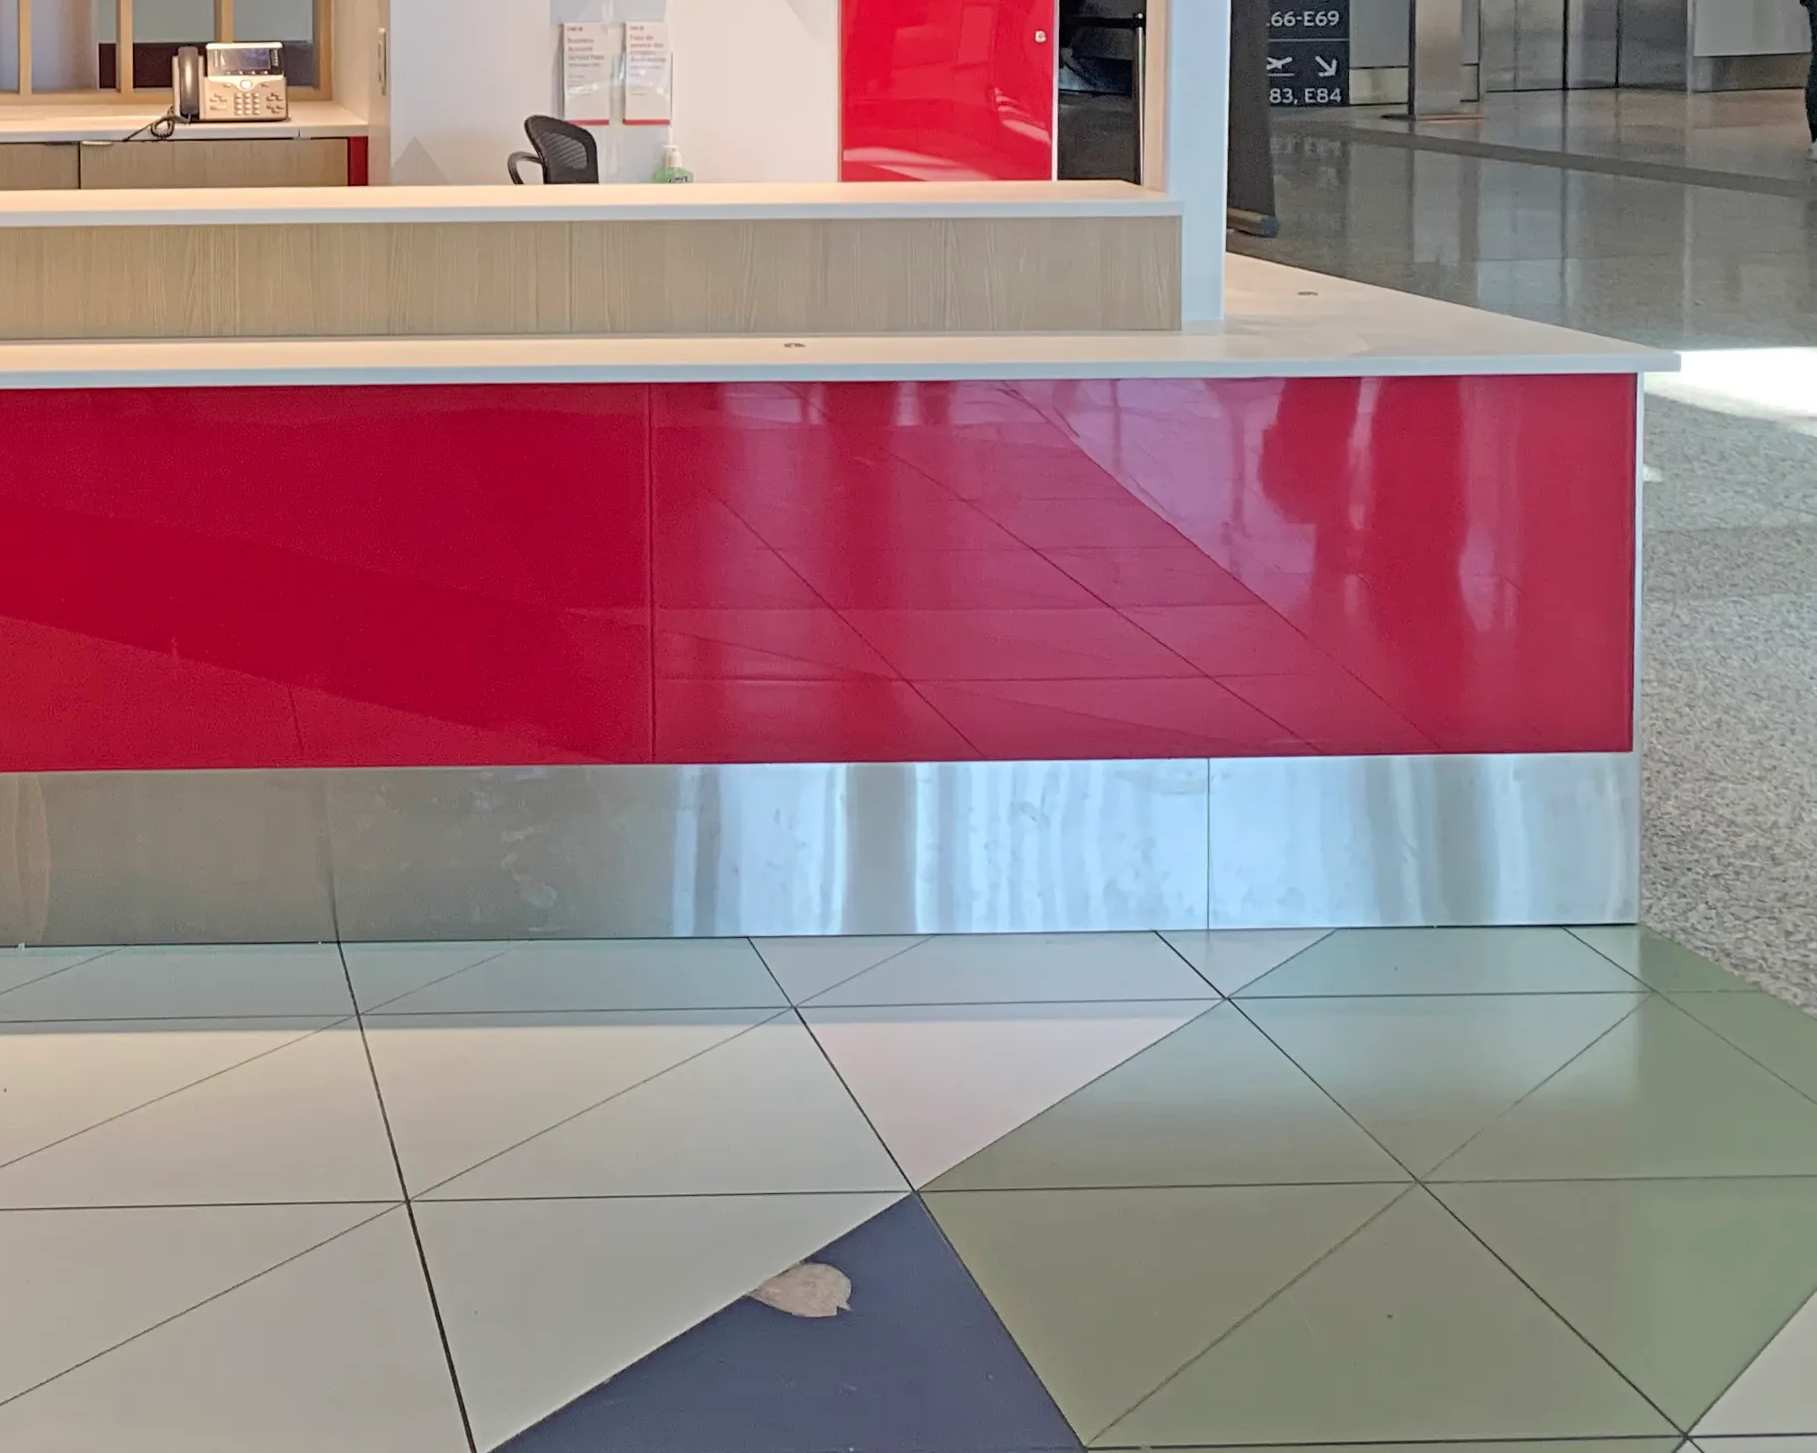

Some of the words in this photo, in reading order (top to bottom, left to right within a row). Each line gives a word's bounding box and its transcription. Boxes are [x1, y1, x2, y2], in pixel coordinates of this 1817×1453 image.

[1266, 11, 1340, 27] 66-E69
[1269, 88, 1298, 105] 83,
[1305, 88, 1341, 104] E84
